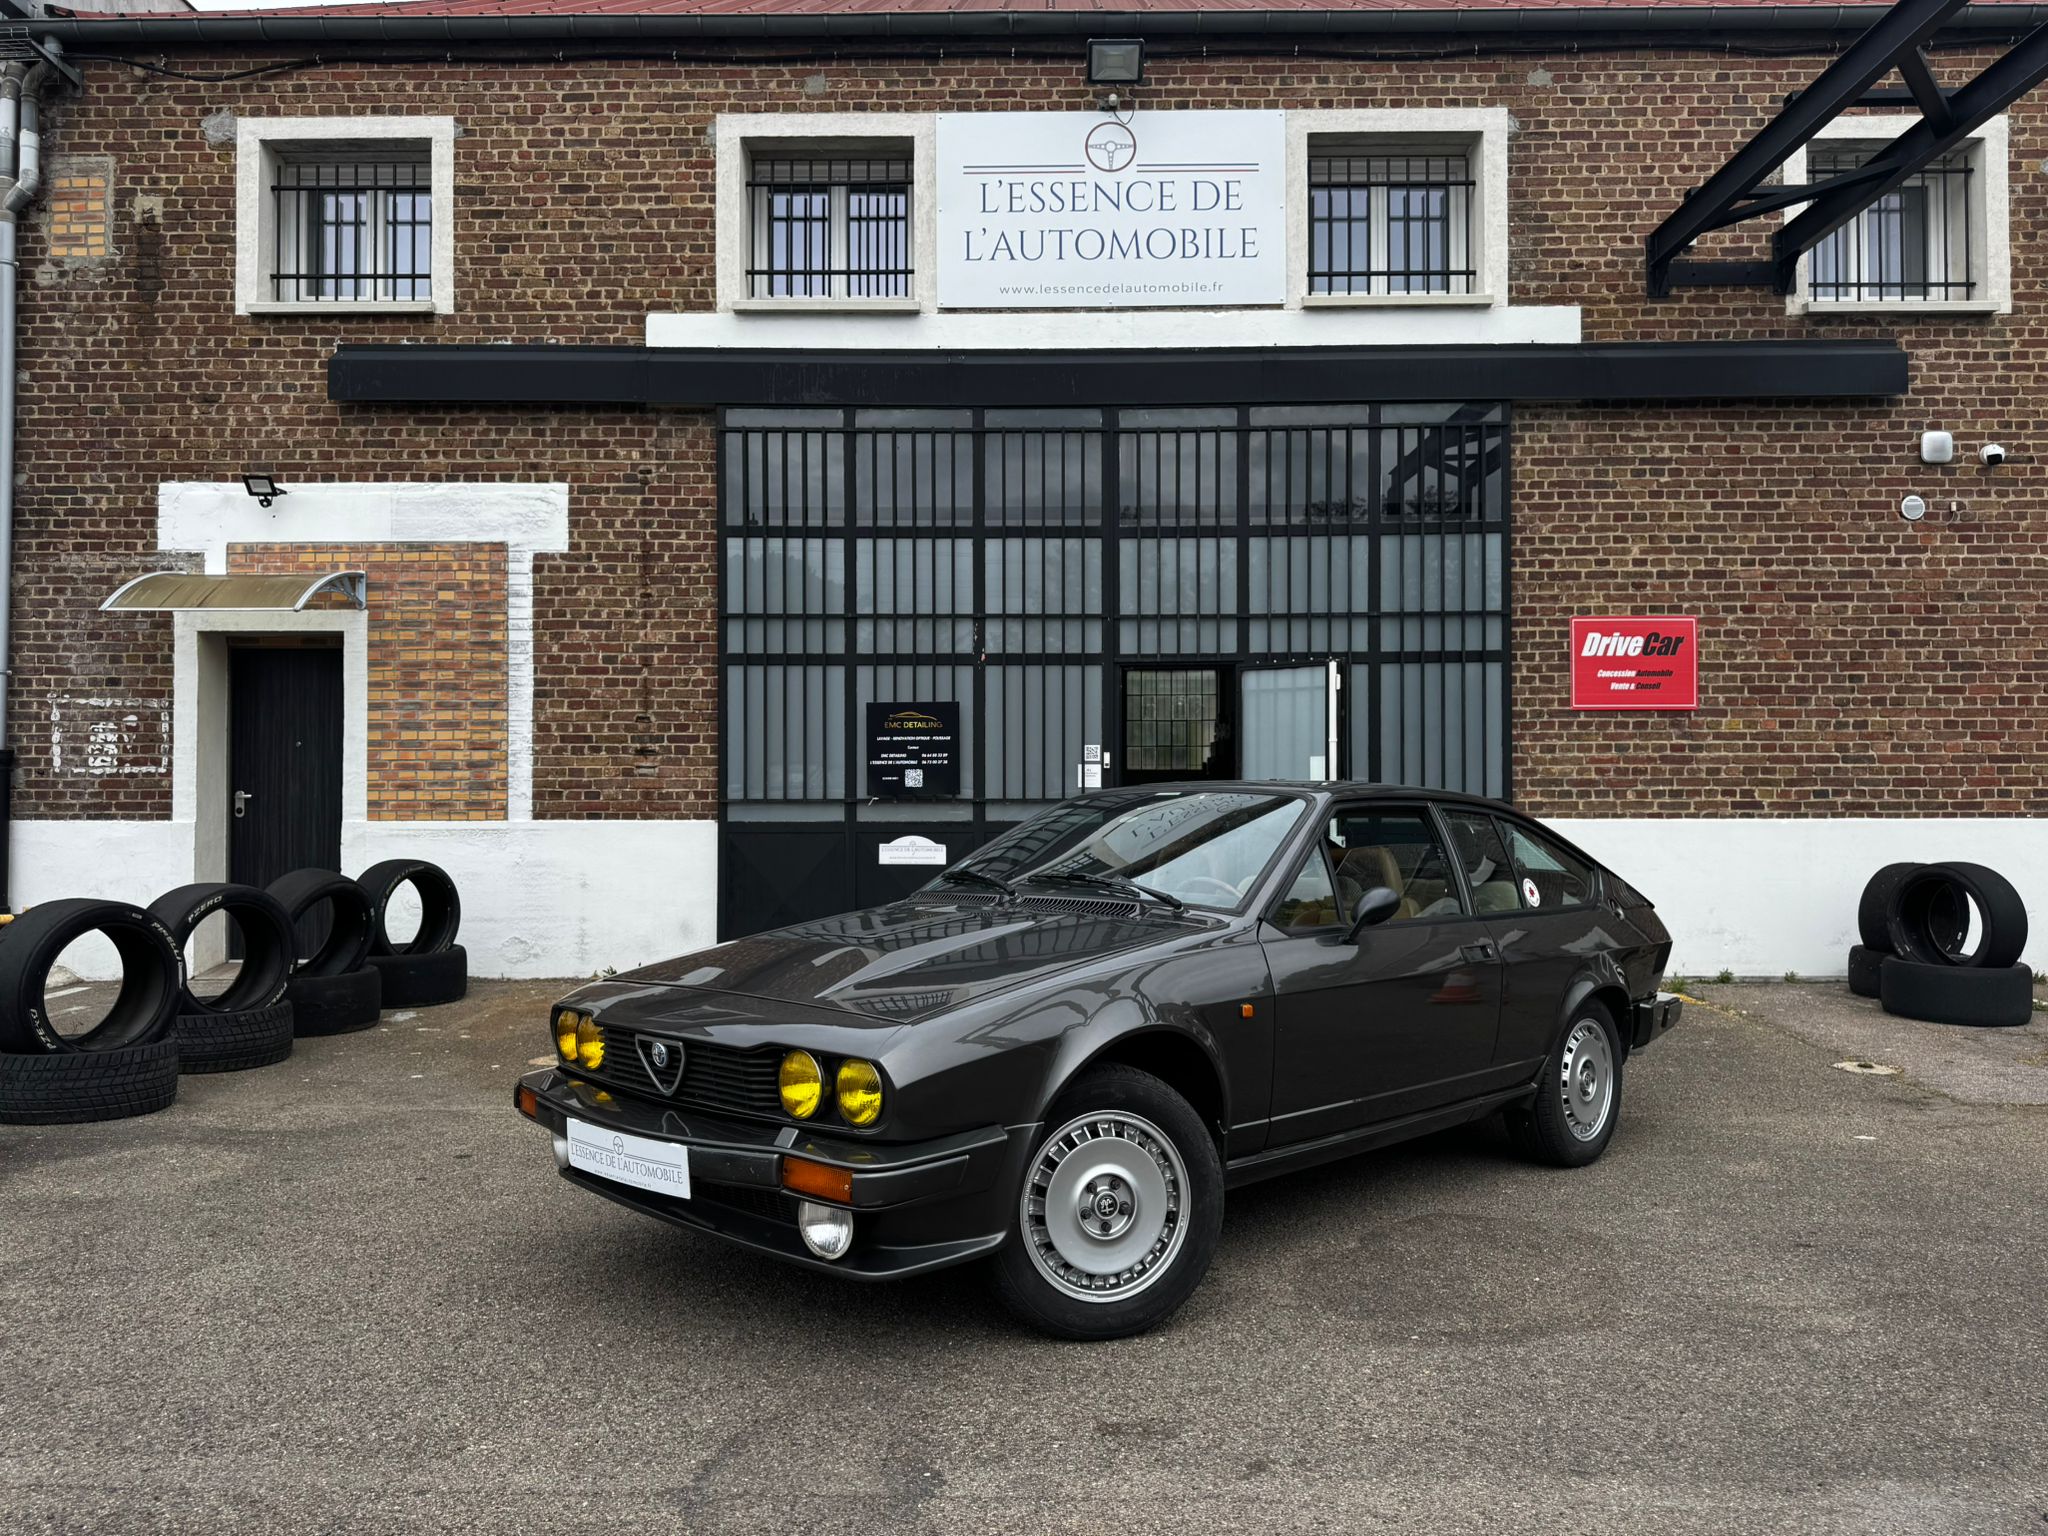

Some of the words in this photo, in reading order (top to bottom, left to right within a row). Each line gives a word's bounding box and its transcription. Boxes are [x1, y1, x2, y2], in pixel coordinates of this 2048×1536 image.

[980, 179, 1177, 214] L'ESSENCE
[1192, 179, 1244, 212] DE
[964, 226, 1260, 262] L'AUTOMOBILE
[999, 281, 1223, 295] www.lessencedelautomobile.fr
[1581, 632, 1684, 656] DriveCar
[1597, 669, 1636, 678] Concession
[1610, 682, 1630, 690] Vente
[1636, 682, 1661, 690] Conseil
[571, 1143, 604, 1165] L'ESSENCE
[606, 1154, 616, 1168] DE
[618, 1157, 683, 1184] L'AUTOMOBILE
